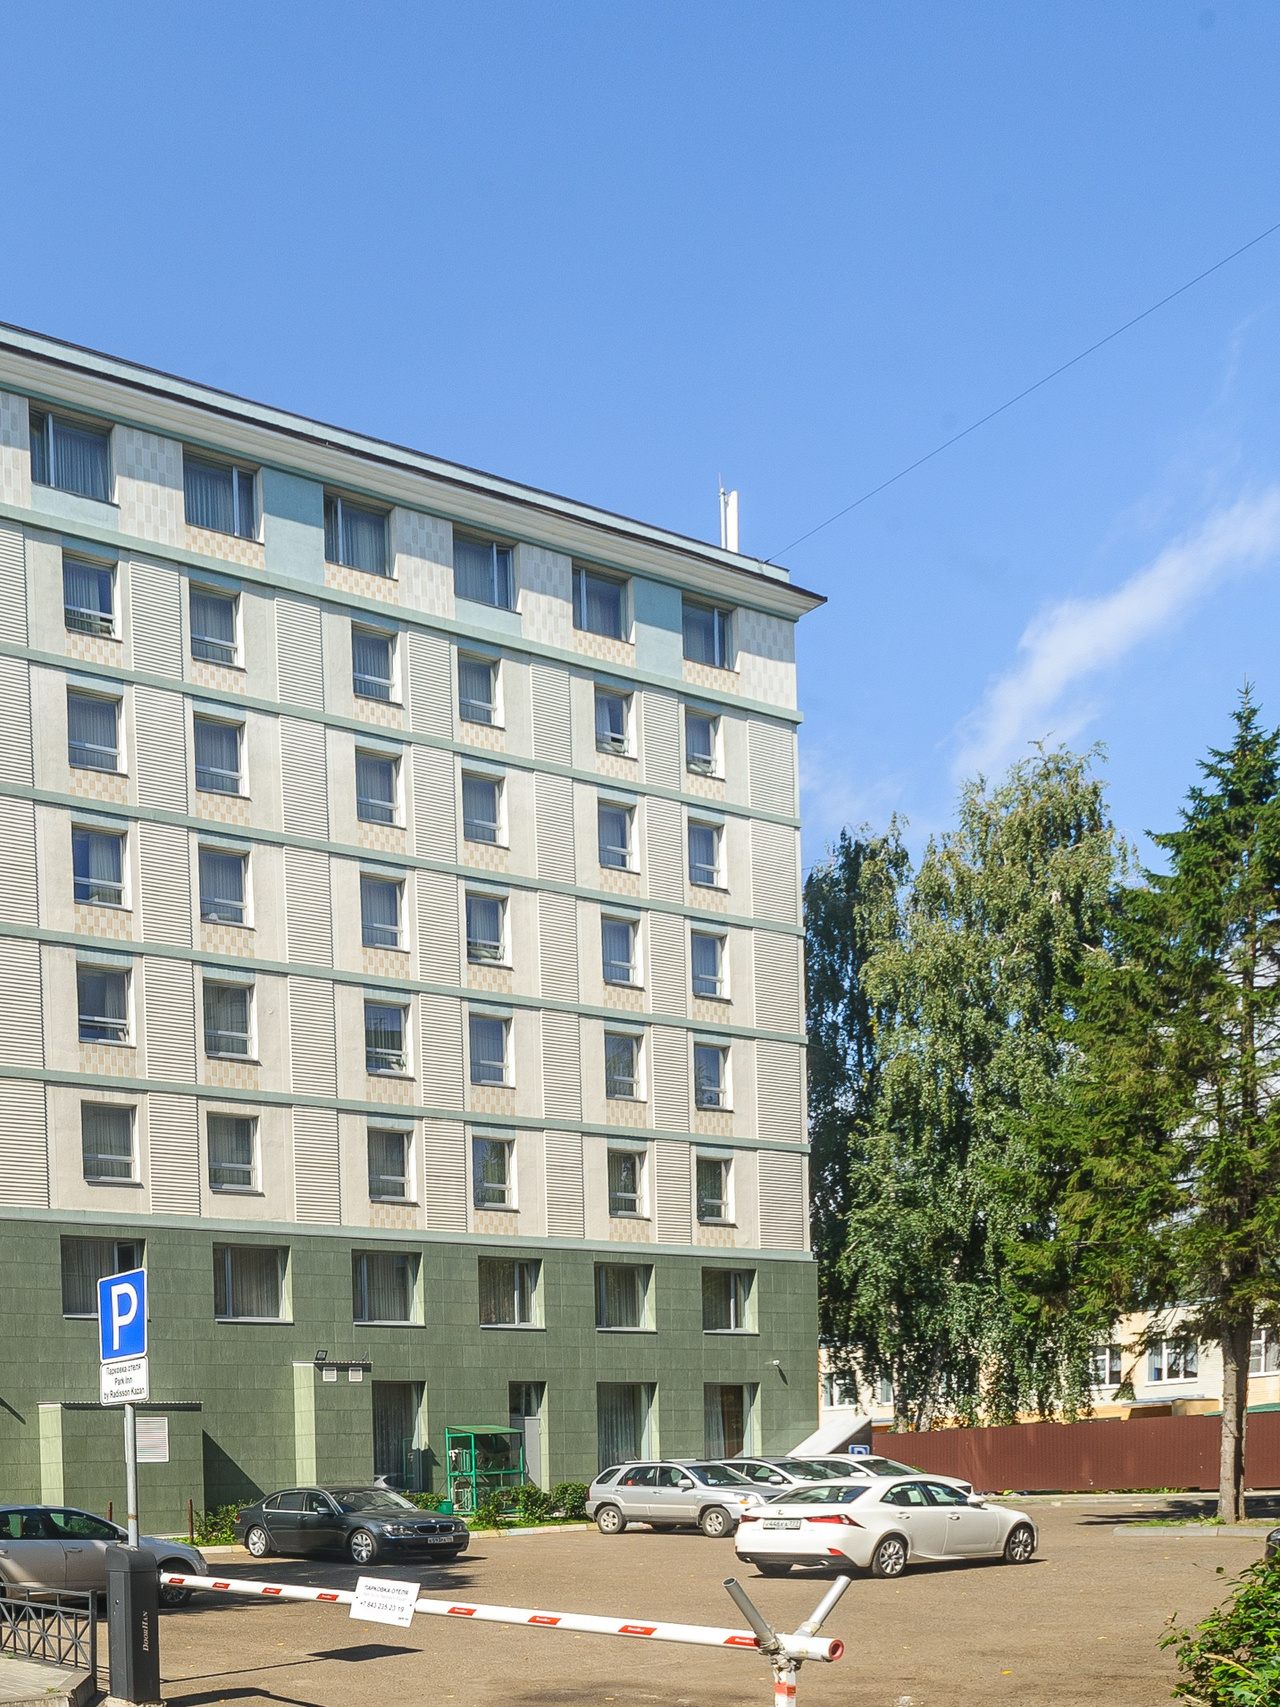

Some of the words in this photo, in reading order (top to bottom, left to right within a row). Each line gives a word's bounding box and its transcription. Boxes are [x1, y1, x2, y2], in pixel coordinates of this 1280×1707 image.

[111, 1283, 138, 1351] P
[106, 1366, 127, 1376] Парковка
[114, 1377, 124, 1386] Park
[125, 1376, 133, 1384] Inn
[104, 1392, 109, 1401] by
[110, 1389, 130, 1399] Radisson
[131, 1387, 145, 1396] Kazan
